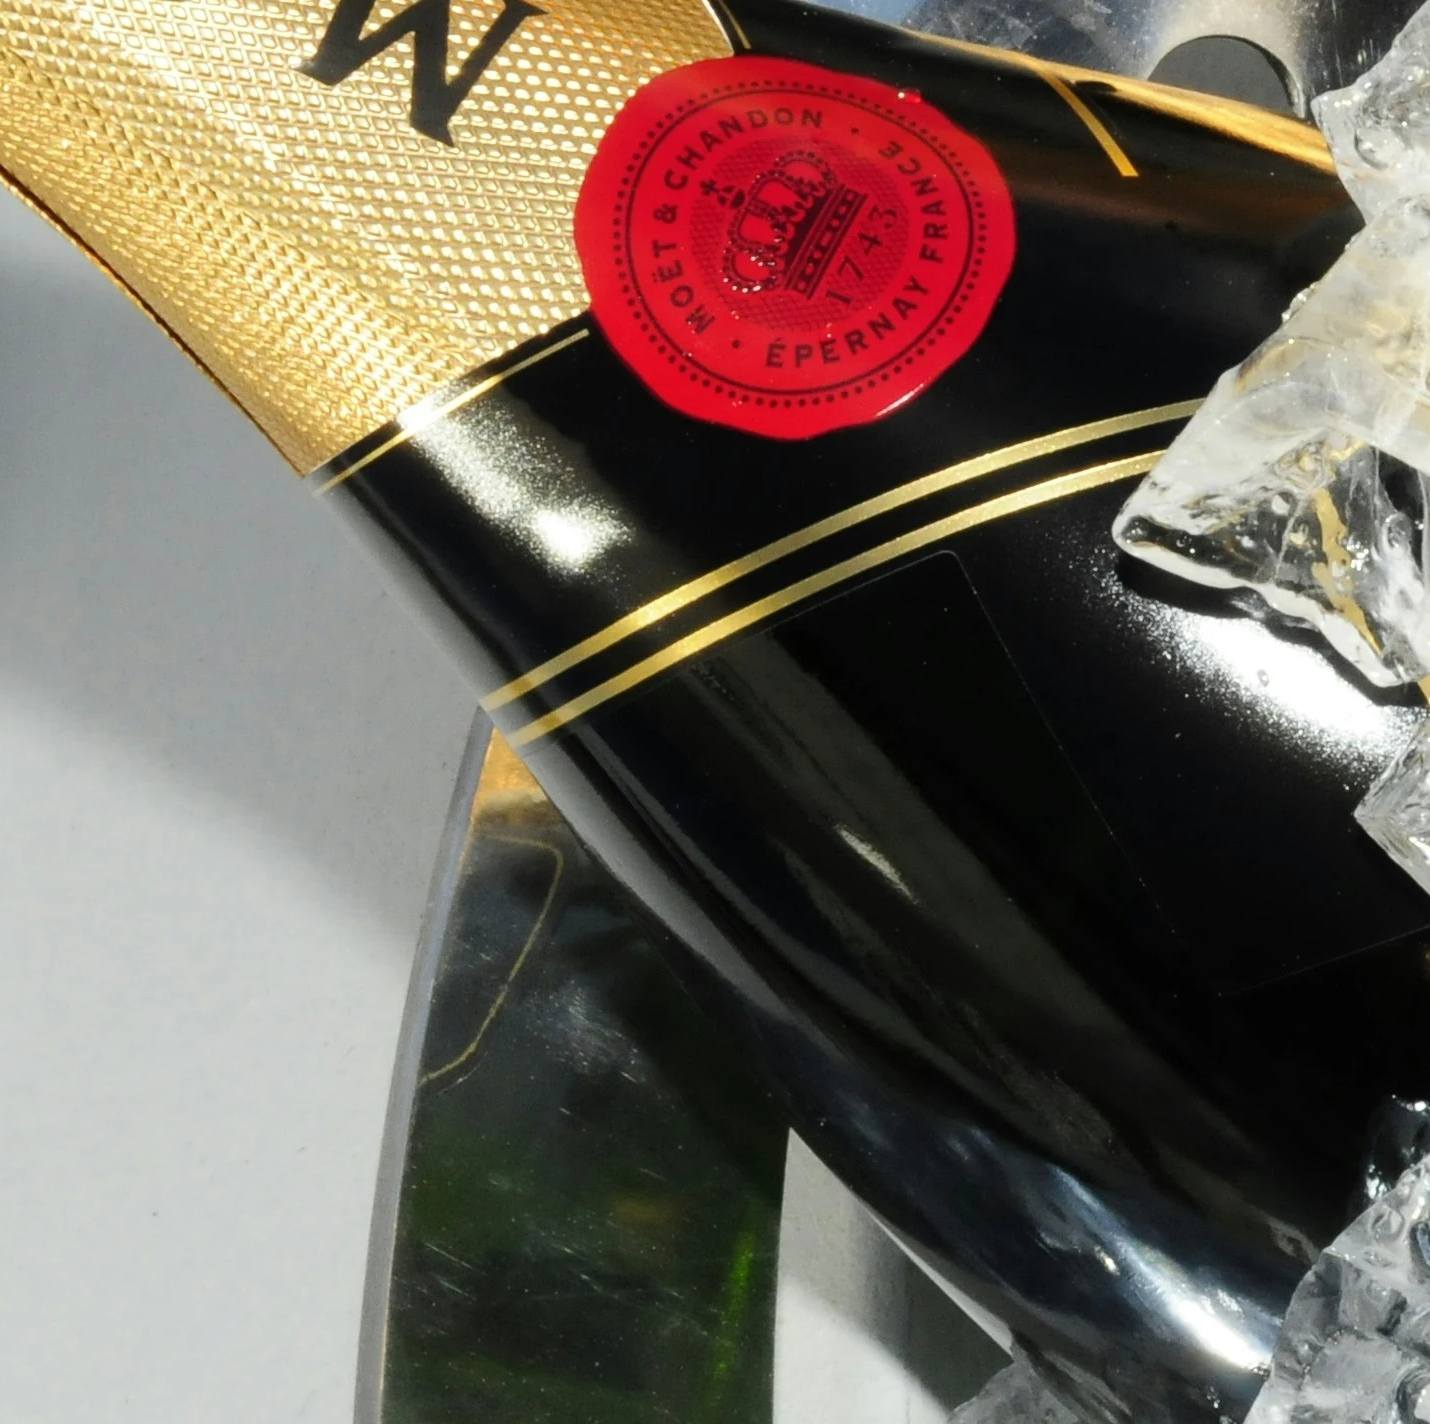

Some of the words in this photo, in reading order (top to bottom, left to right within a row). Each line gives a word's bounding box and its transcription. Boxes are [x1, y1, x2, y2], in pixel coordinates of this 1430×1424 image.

[665, 108, 823, 191] CHANDON
[654, 203, 677, 224] &
[767, 277, 929, 367] ÉPERNAY
[880, 141, 949, 263] FRANCE
[826, 207, 897, 305] 1743
[654, 240, 715, 335] MOËT
